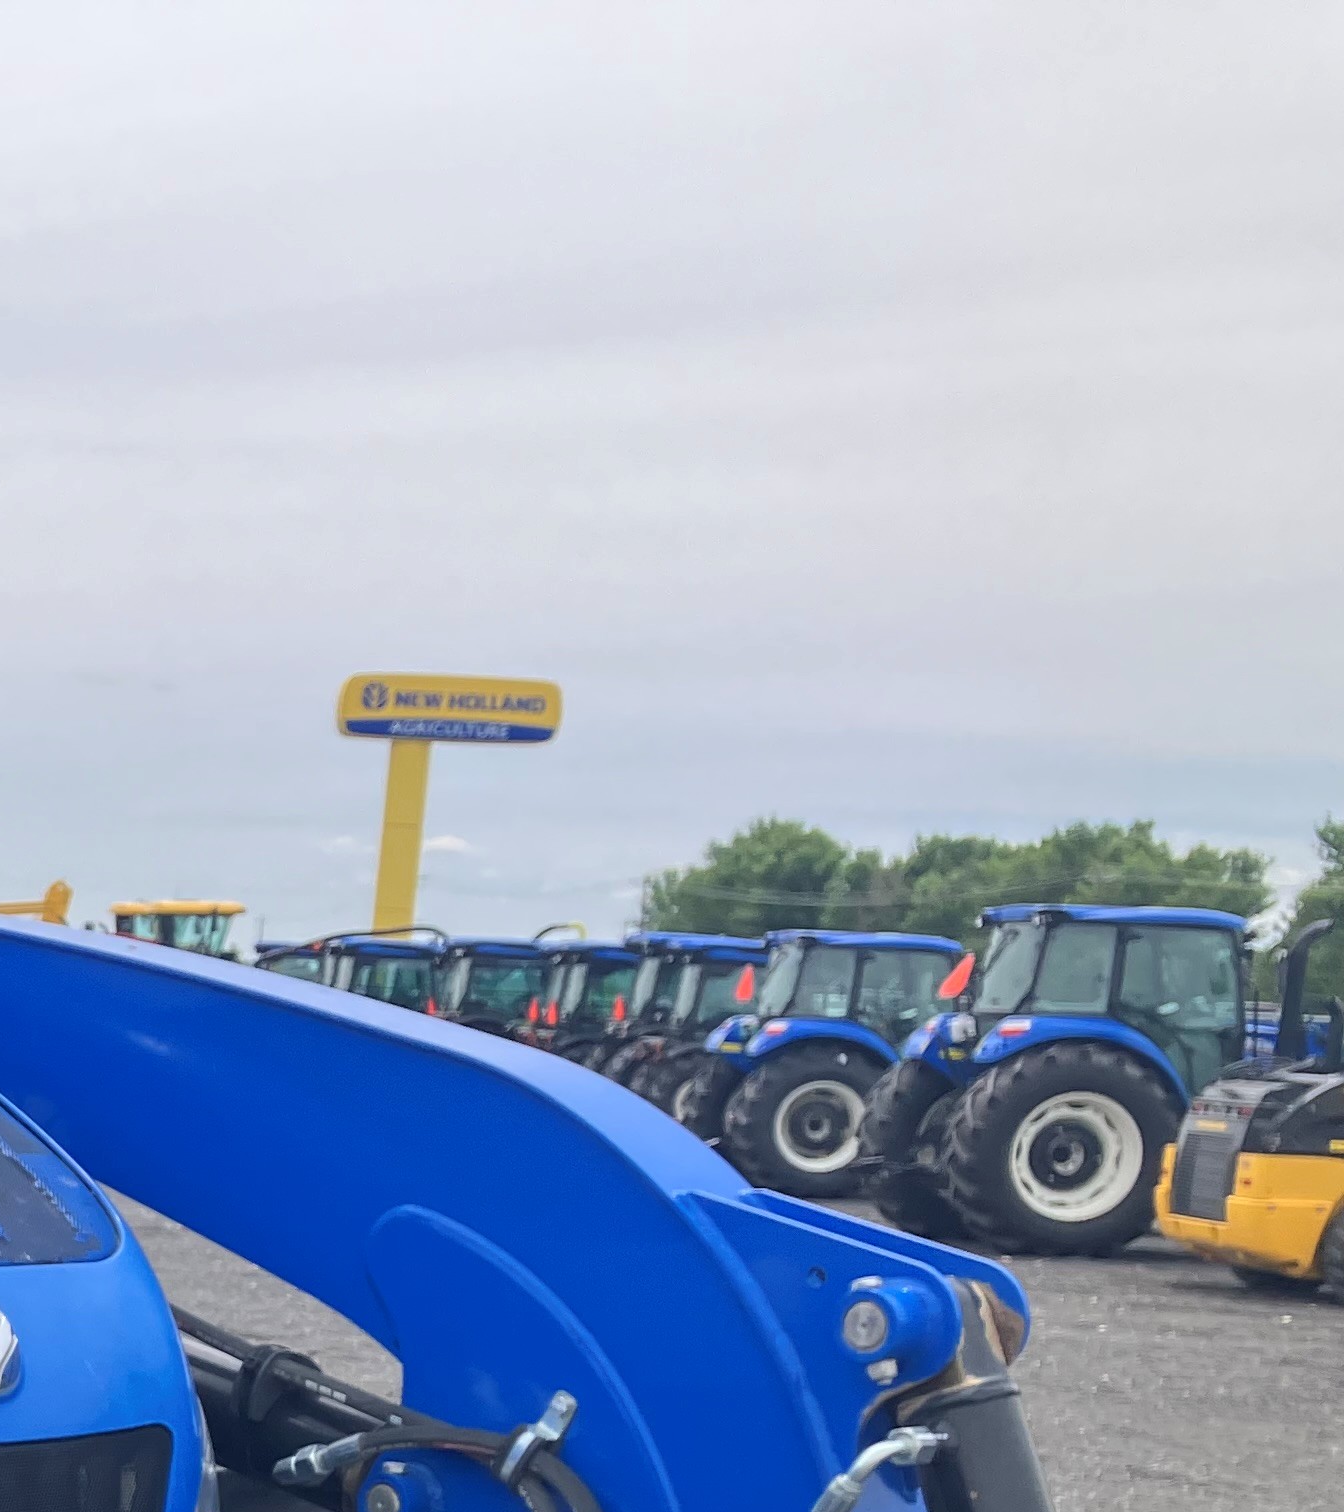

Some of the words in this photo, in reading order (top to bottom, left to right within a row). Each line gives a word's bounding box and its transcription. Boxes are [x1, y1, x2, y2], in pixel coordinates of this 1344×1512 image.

[395, 690, 443, 708] NEW
[448, 692, 547, 714] HOLLAND
[389, 720, 510, 739] AGRICULTURE
